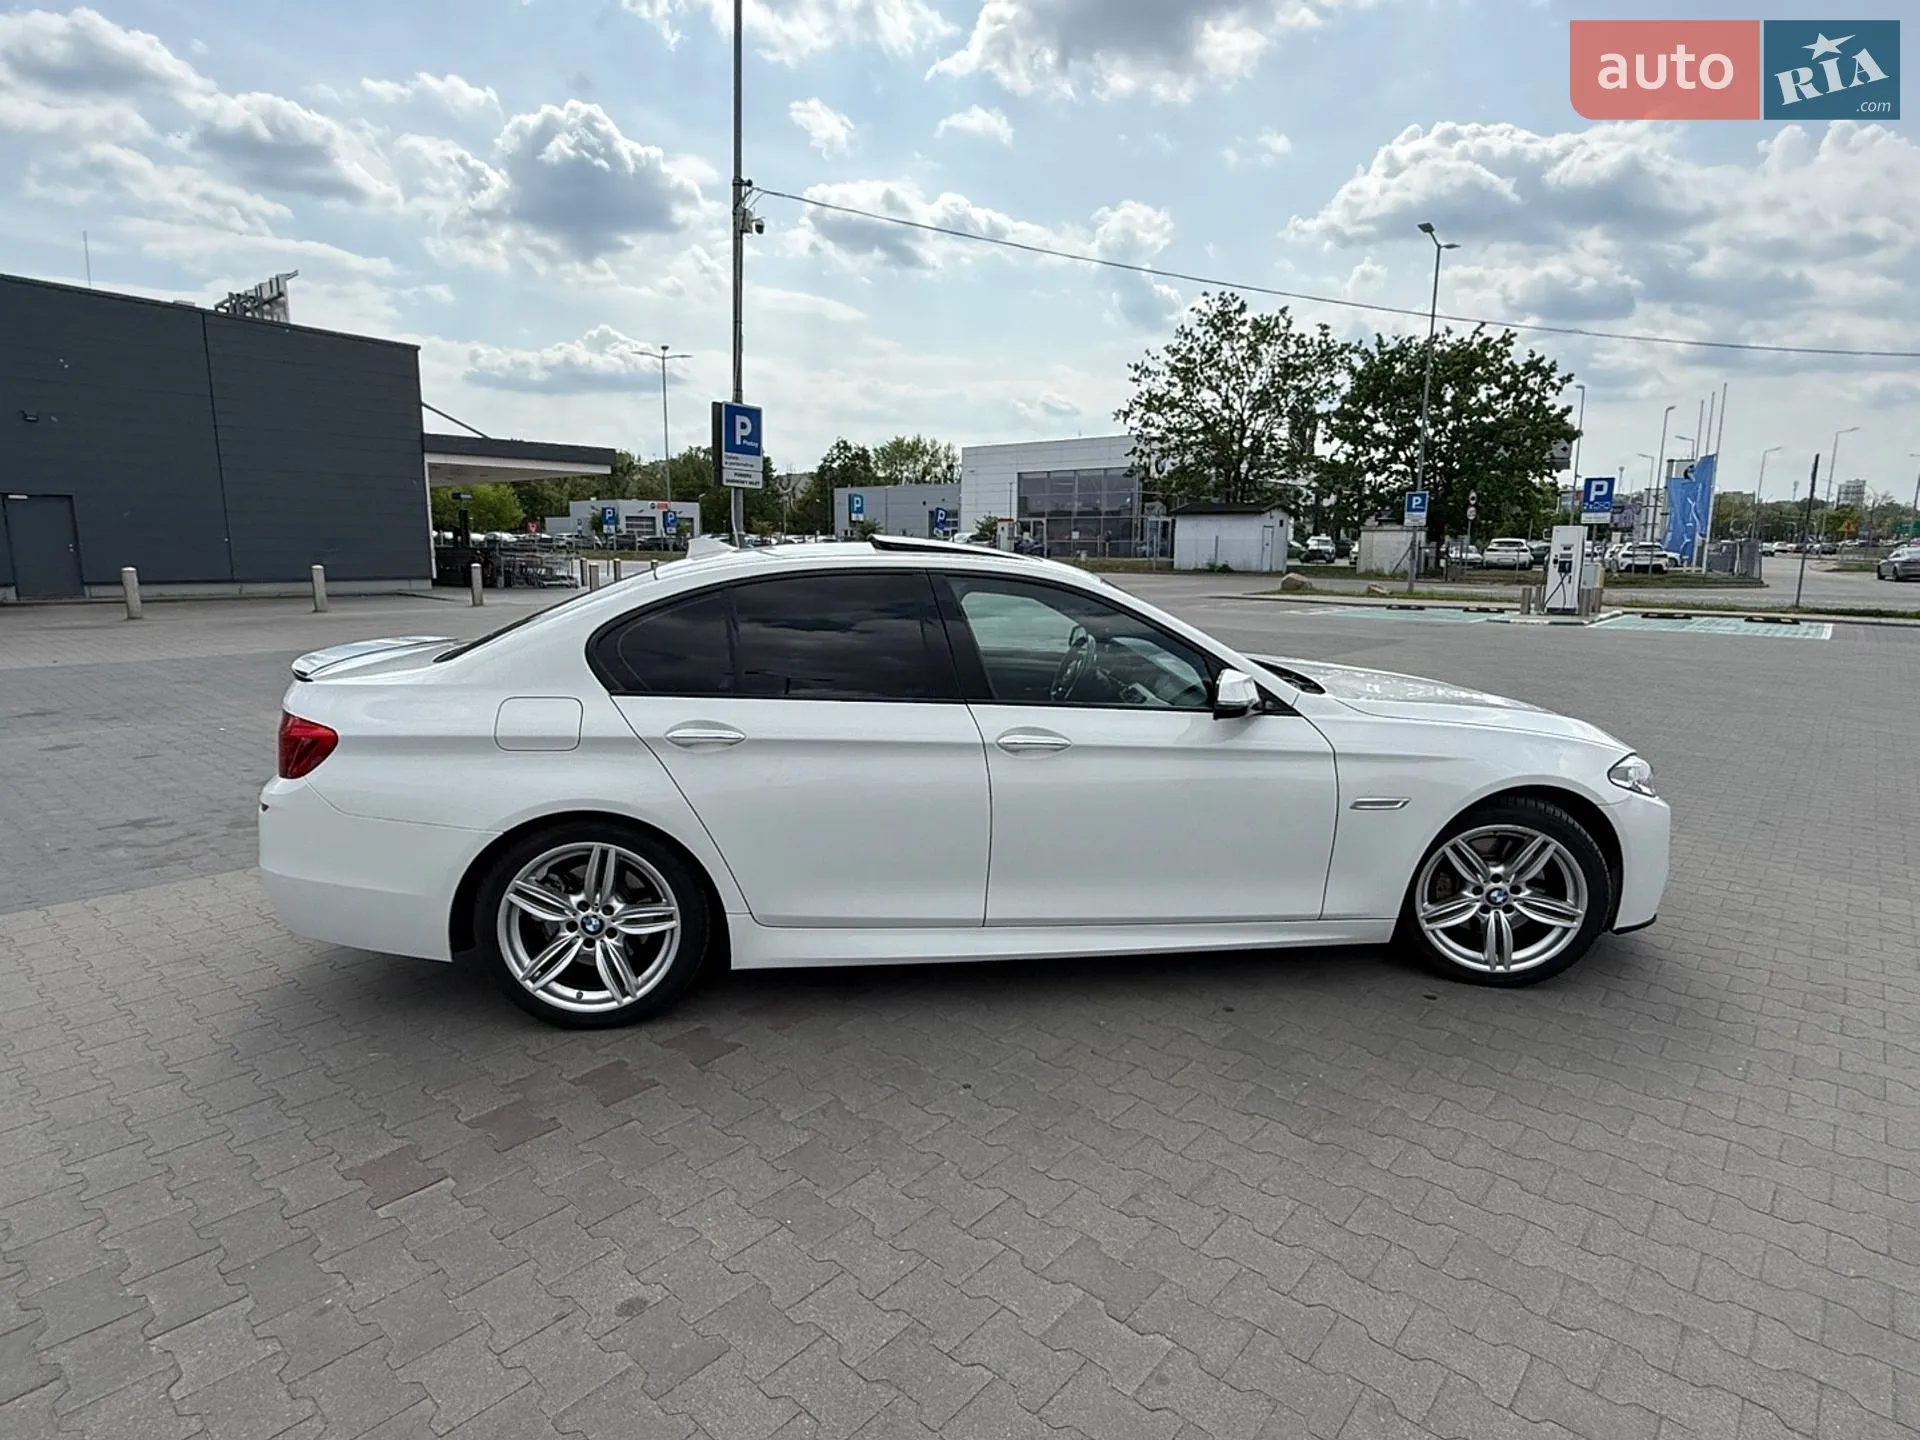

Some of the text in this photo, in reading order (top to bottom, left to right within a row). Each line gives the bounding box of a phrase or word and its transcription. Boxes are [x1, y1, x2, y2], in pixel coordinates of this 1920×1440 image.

[735, 414, 752, 445] P
[1589, 480, 1609, 501] P
[854, 497, 861, 511] P
[1412, 496, 1422, 509] P
[606, 509, 613, 520] P
[668, 511, 675, 523] P
[937, 510, 945, 522] P
